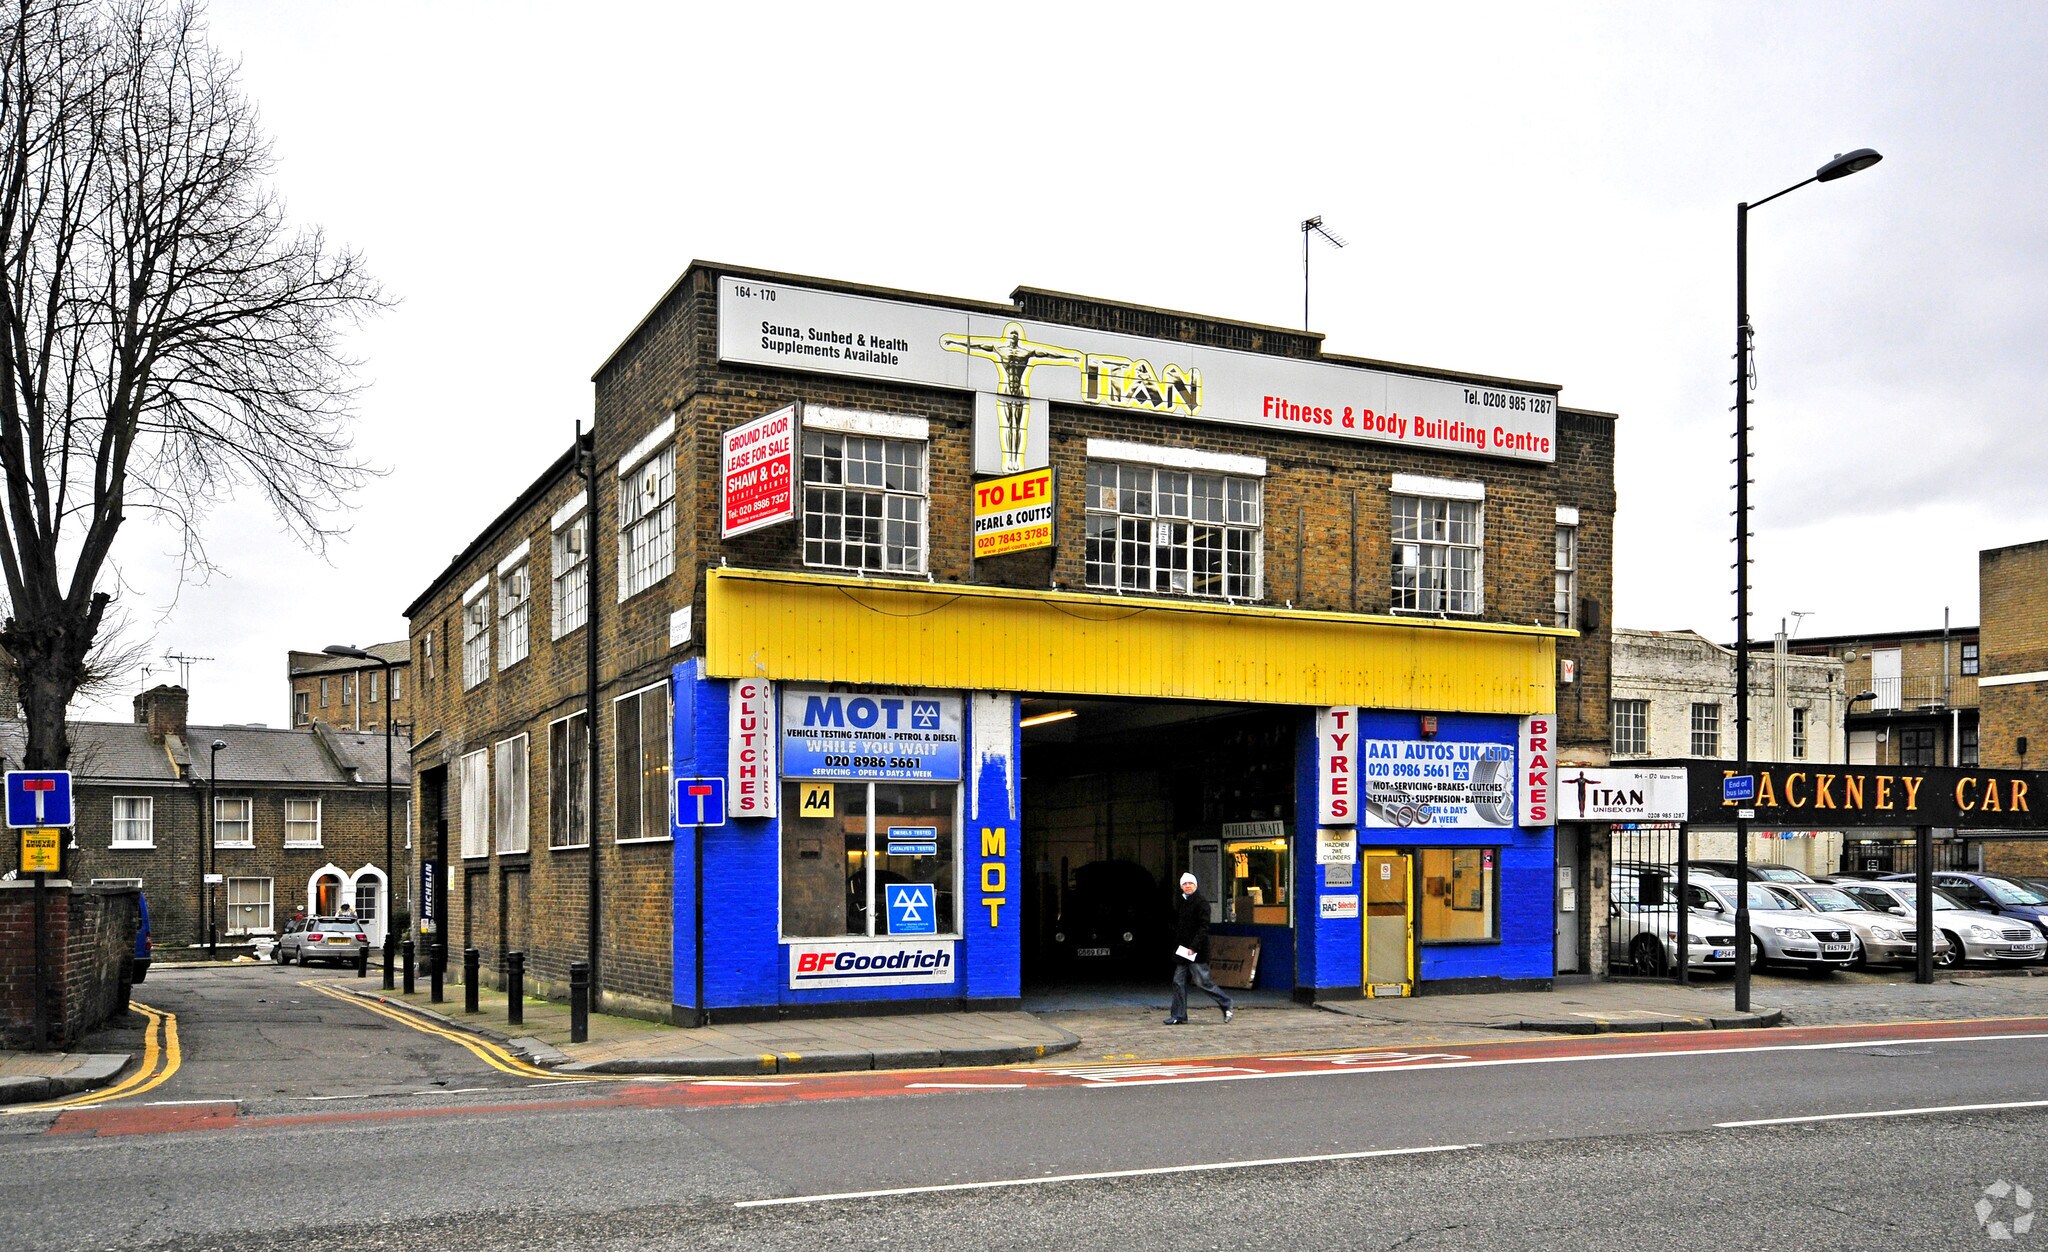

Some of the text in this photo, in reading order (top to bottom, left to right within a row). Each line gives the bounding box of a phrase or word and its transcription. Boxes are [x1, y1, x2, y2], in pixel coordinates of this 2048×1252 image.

[735, 285, 751, 299] 164
[760, 288, 777, 302] 170
[762, 320, 908, 352] Sauna, Sunbed & Health
[761, 336, 899, 366] Supplements Available
[1464, 388, 1552, 414] Tel. 0208 985 1287
[729, 416, 788, 452] GROUND FLOOR
[1262, 395, 1550, 454] Fitness & Body Building Centre
[727, 436, 790, 473] LEASE FOR SALE
[727, 476, 789, 504] ESTATE AGENTS
[728, 461, 789, 494] SHAW & Co.
[978, 476, 1049, 508] TO LET
[727, 491, 789, 520] Tel: 020 8986 7327
[976, 506, 1052, 532] PEARL & COUTTS
[978, 526, 1049, 549] 020 7843 3788
[803, 695, 904, 730] MOT
[740, 685, 756, 810] CLUTCHES
[786, 729, 818, 739] VEHICLE
[820, 730, 852, 740] TESTING
[854, 731, 887, 741] STATION
[894, 732, 923, 742] PETROL
[925, 733, 931, 742] &
[933, 733, 957, 743] DIESEL
[805, 739, 939, 756] WHILE YOU WAIT
[824, 755, 921, 769] 020 8986 5661
[1331, 711, 1349, 818] TYRES
[1368, 743, 1511, 762] AA1 AUTOS UK LTD
[812, 768, 851, 776] SERVICING
[858, 769, 878, 777] OPEN
[879, 769, 885, 777] 6
[886, 769, 904, 778] DAYS
[905, 770, 912, 778] A
[913, 770, 932, 778] WEEK
[1368, 763, 1450, 778] 020 8986 5661
[1529, 720, 1549, 821] BRAKES
[1372, 781, 1503, 792] MOT SERVICING BRAKES CLUTCHES
[1726, 788, 1751, 797] bus lane
[1728, 780, 1748, 789] End of
[1956, 776, 2030, 812] CAR
[804, 789, 831, 810] AA
[1372, 794, 1502, 804] EXHAUSTS SUSPENSION BATTERIES
[1422, 806, 1468, 815] OPEN 6 DAYS
[1224, 822, 1282, 837] WHILE-U-WAIT
[1431, 816, 1459, 824] A WEEK
[425, 863, 433, 917] MICHELIN
[981, 827, 1006, 928] MOT
[1322, 903, 1338, 912] RAC
[796, 950, 951, 974] BFGoodrich
